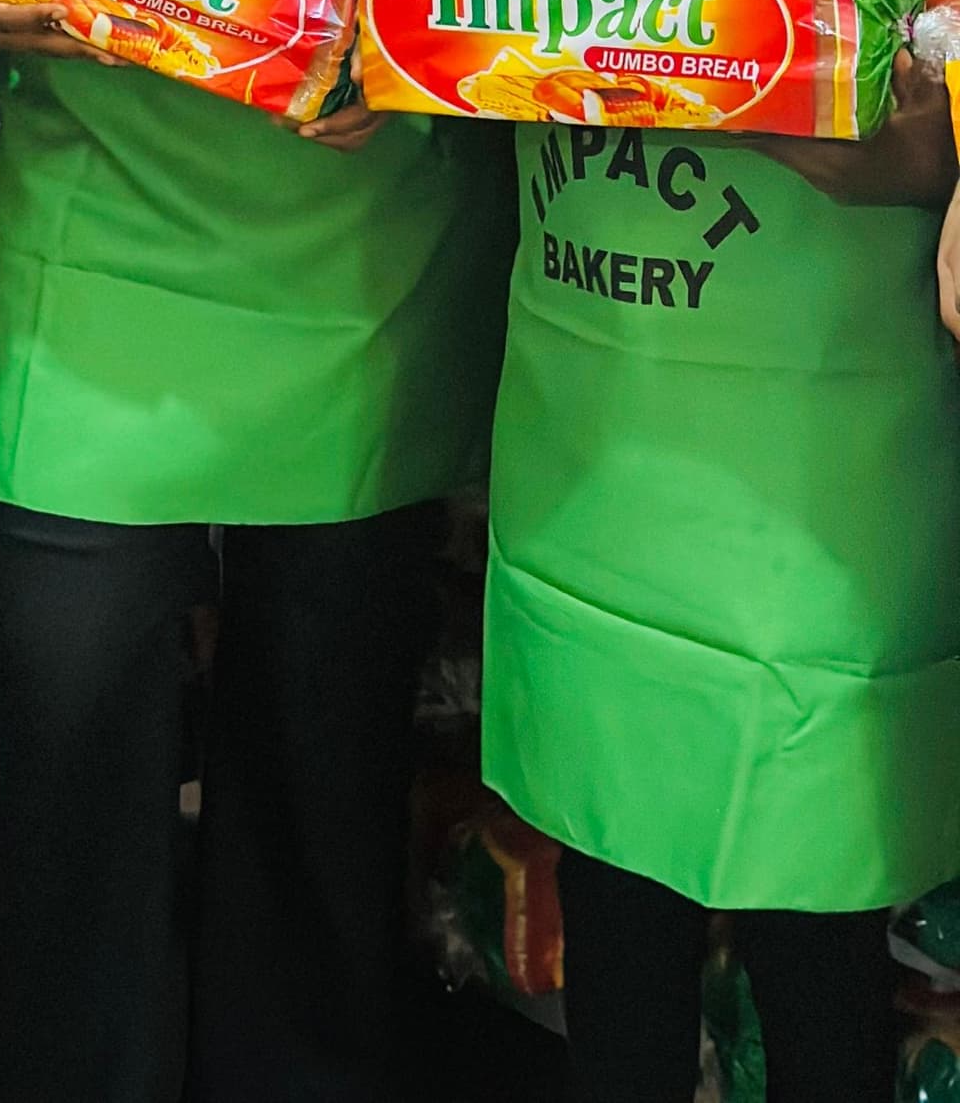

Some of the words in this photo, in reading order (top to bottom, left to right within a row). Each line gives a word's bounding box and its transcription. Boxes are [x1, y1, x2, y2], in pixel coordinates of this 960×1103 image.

[196, 14, 270, 45] BREAD
[595, 49, 676, 74] JUMBO
[680, 56, 760, 82] BREAD
[543, 231, 715, 309] BAKERY
